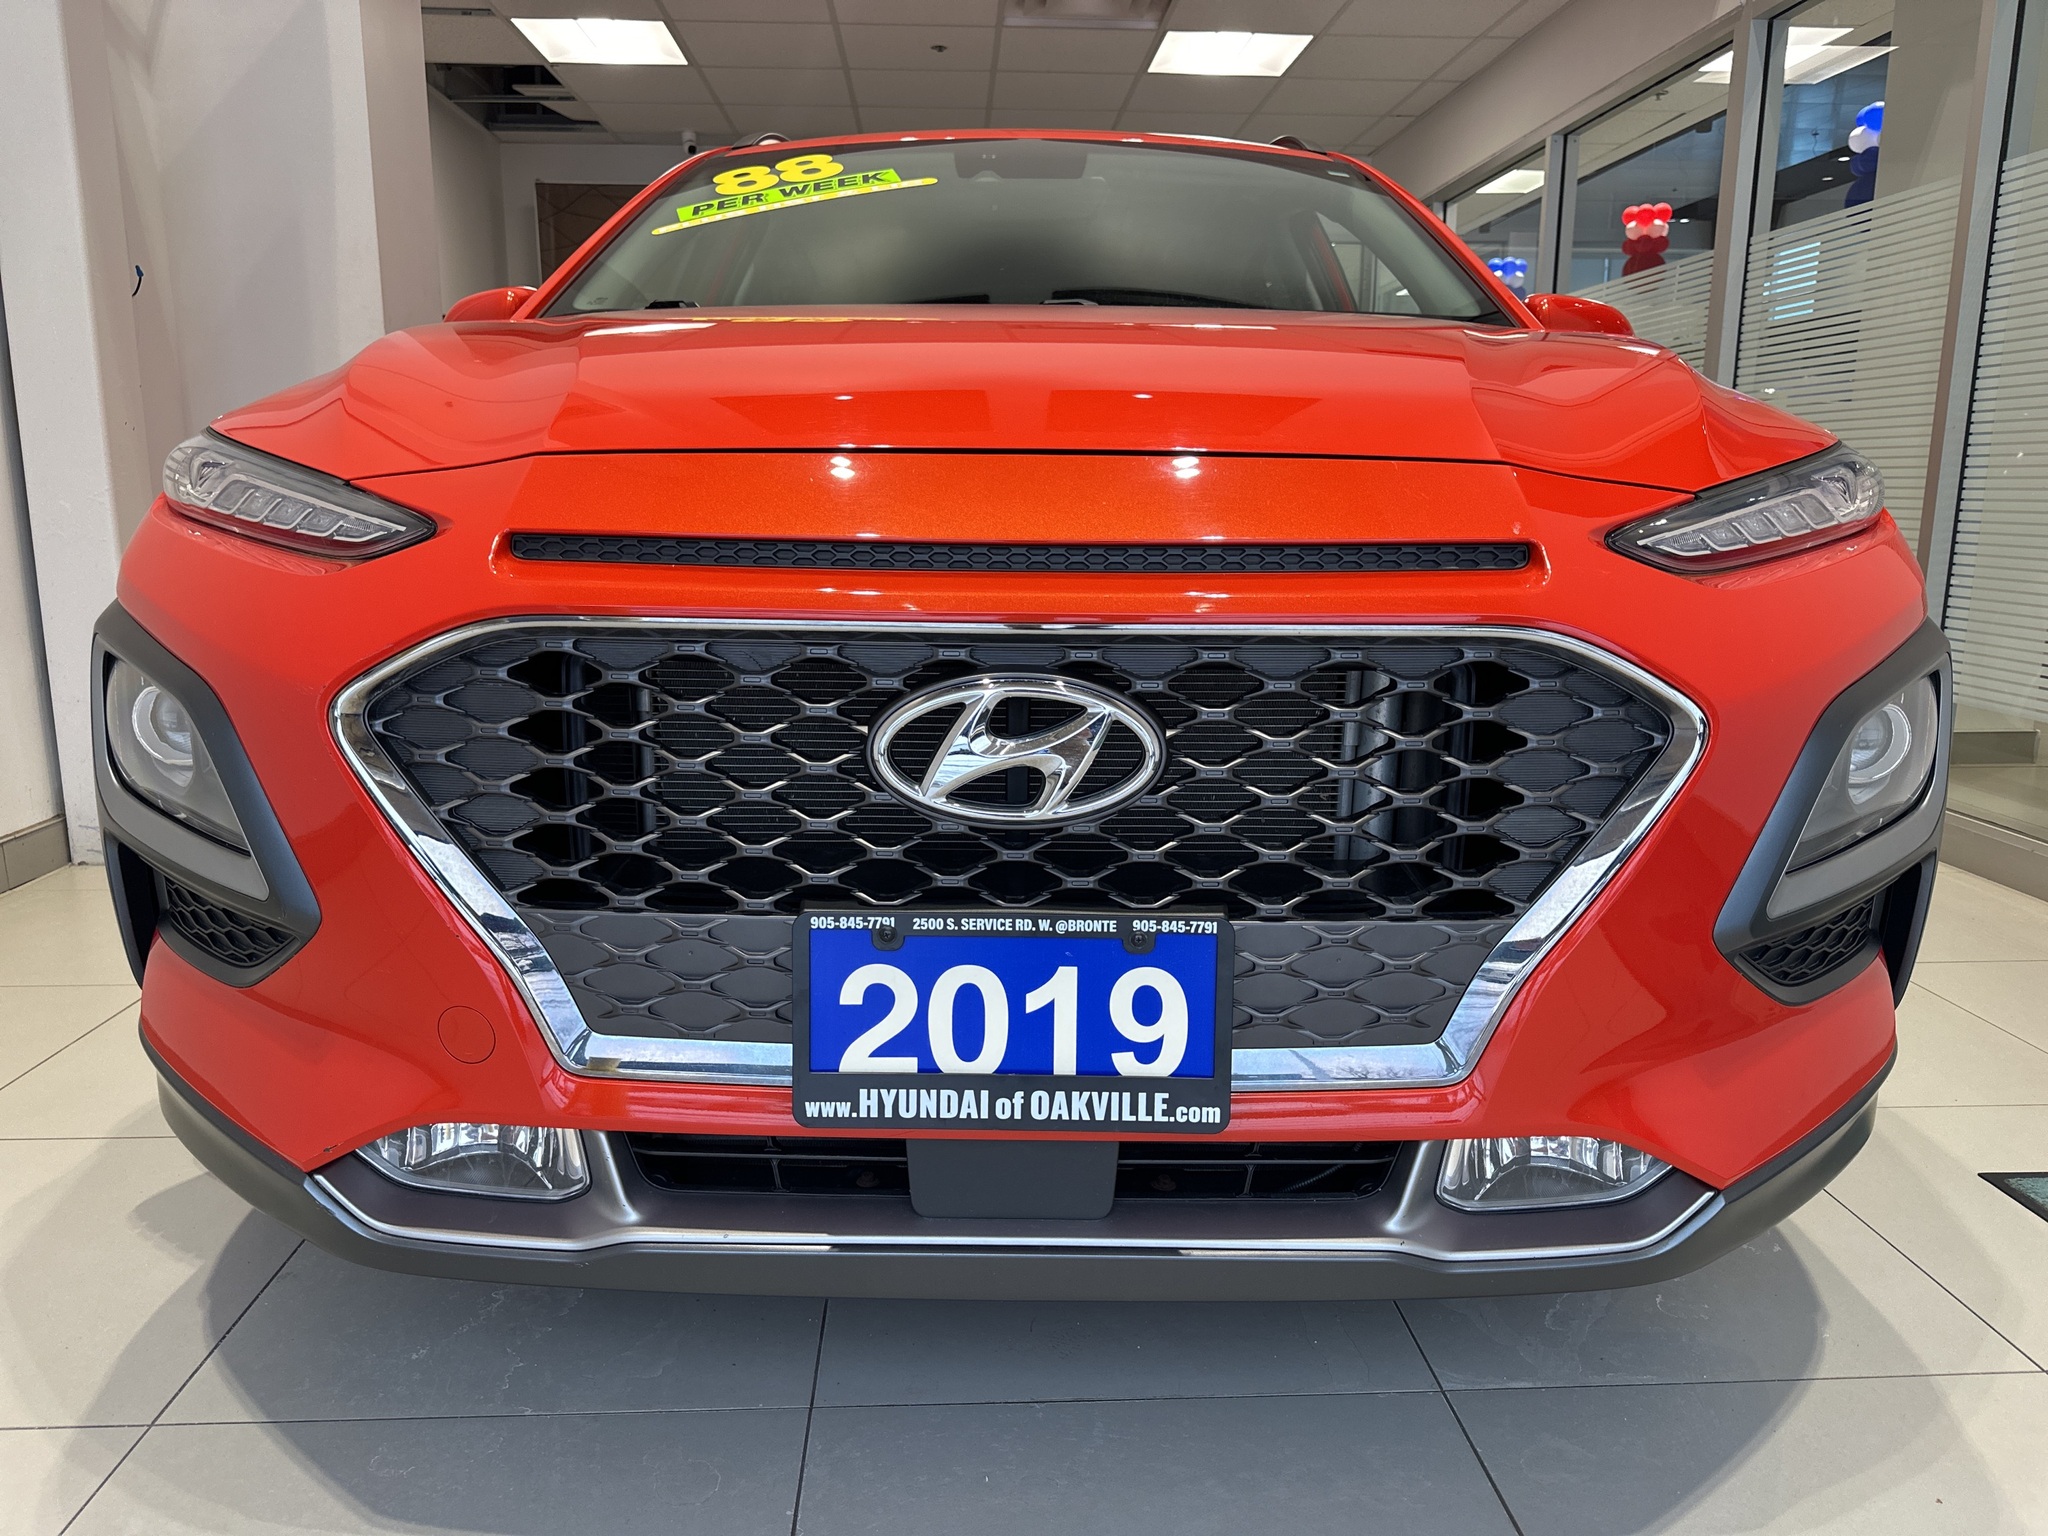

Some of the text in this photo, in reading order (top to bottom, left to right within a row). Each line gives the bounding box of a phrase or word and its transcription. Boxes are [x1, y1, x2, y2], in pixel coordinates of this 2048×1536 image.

[712, 154, 844, 196] 88
[691, 171, 888, 217] PER WEEK
[810, 916, 895, 930] 905-845-7791
[912, 918, 1117, 934] 2500 S. SERVICE RD. W. @BRONTE
[1132, 919, 1218, 934] 905-845-7791
[838, 963, 1189, 1077] 2019
[804, 1088, 1221, 1123] www.HYUNDAI of OAKVILLE.com
